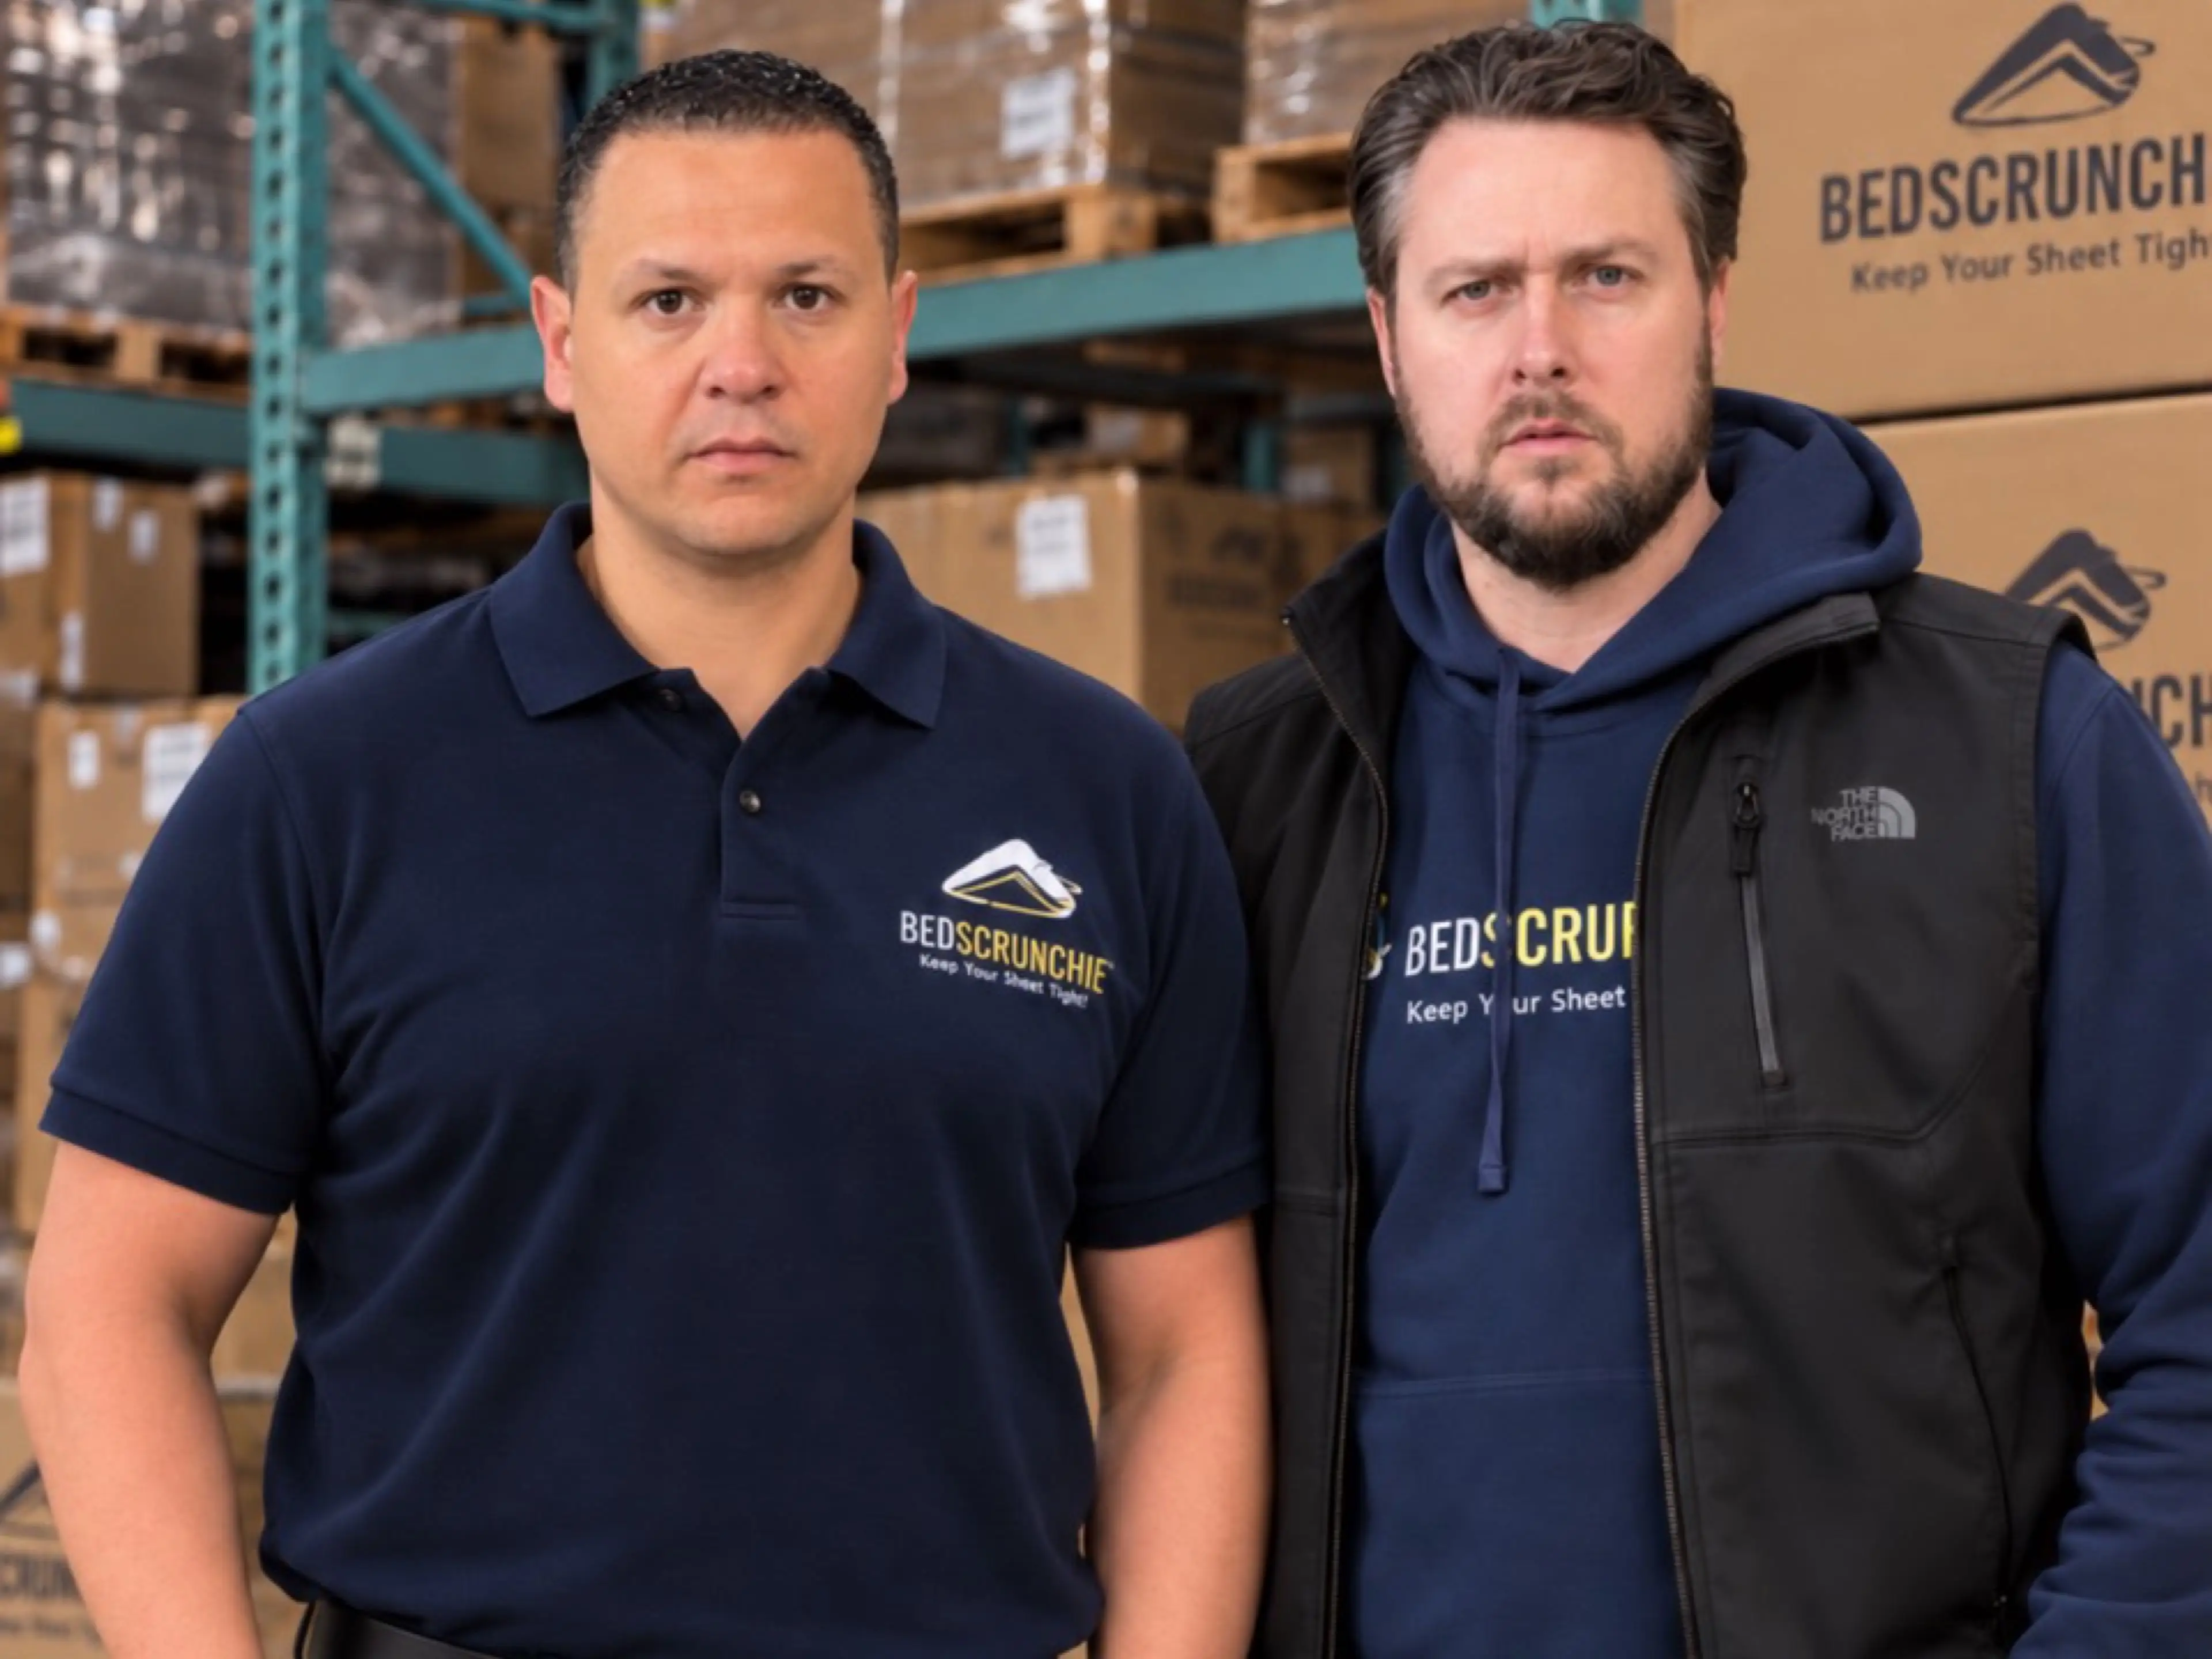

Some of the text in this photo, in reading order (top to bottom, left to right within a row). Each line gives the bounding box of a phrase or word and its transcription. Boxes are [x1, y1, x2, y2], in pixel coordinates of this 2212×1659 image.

[1820, 131, 2205, 245] BEDSCRUNCH
[1851, 260, 1929, 293] Keep
[1940, 252, 2013, 283] Your
[2027, 238, 2120, 276] Sheet
[919, 954, 959, 975] Keep
[964, 962, 998, 982] Your
[1407, 985, 1626, 1024] Keep Yur Sheet
